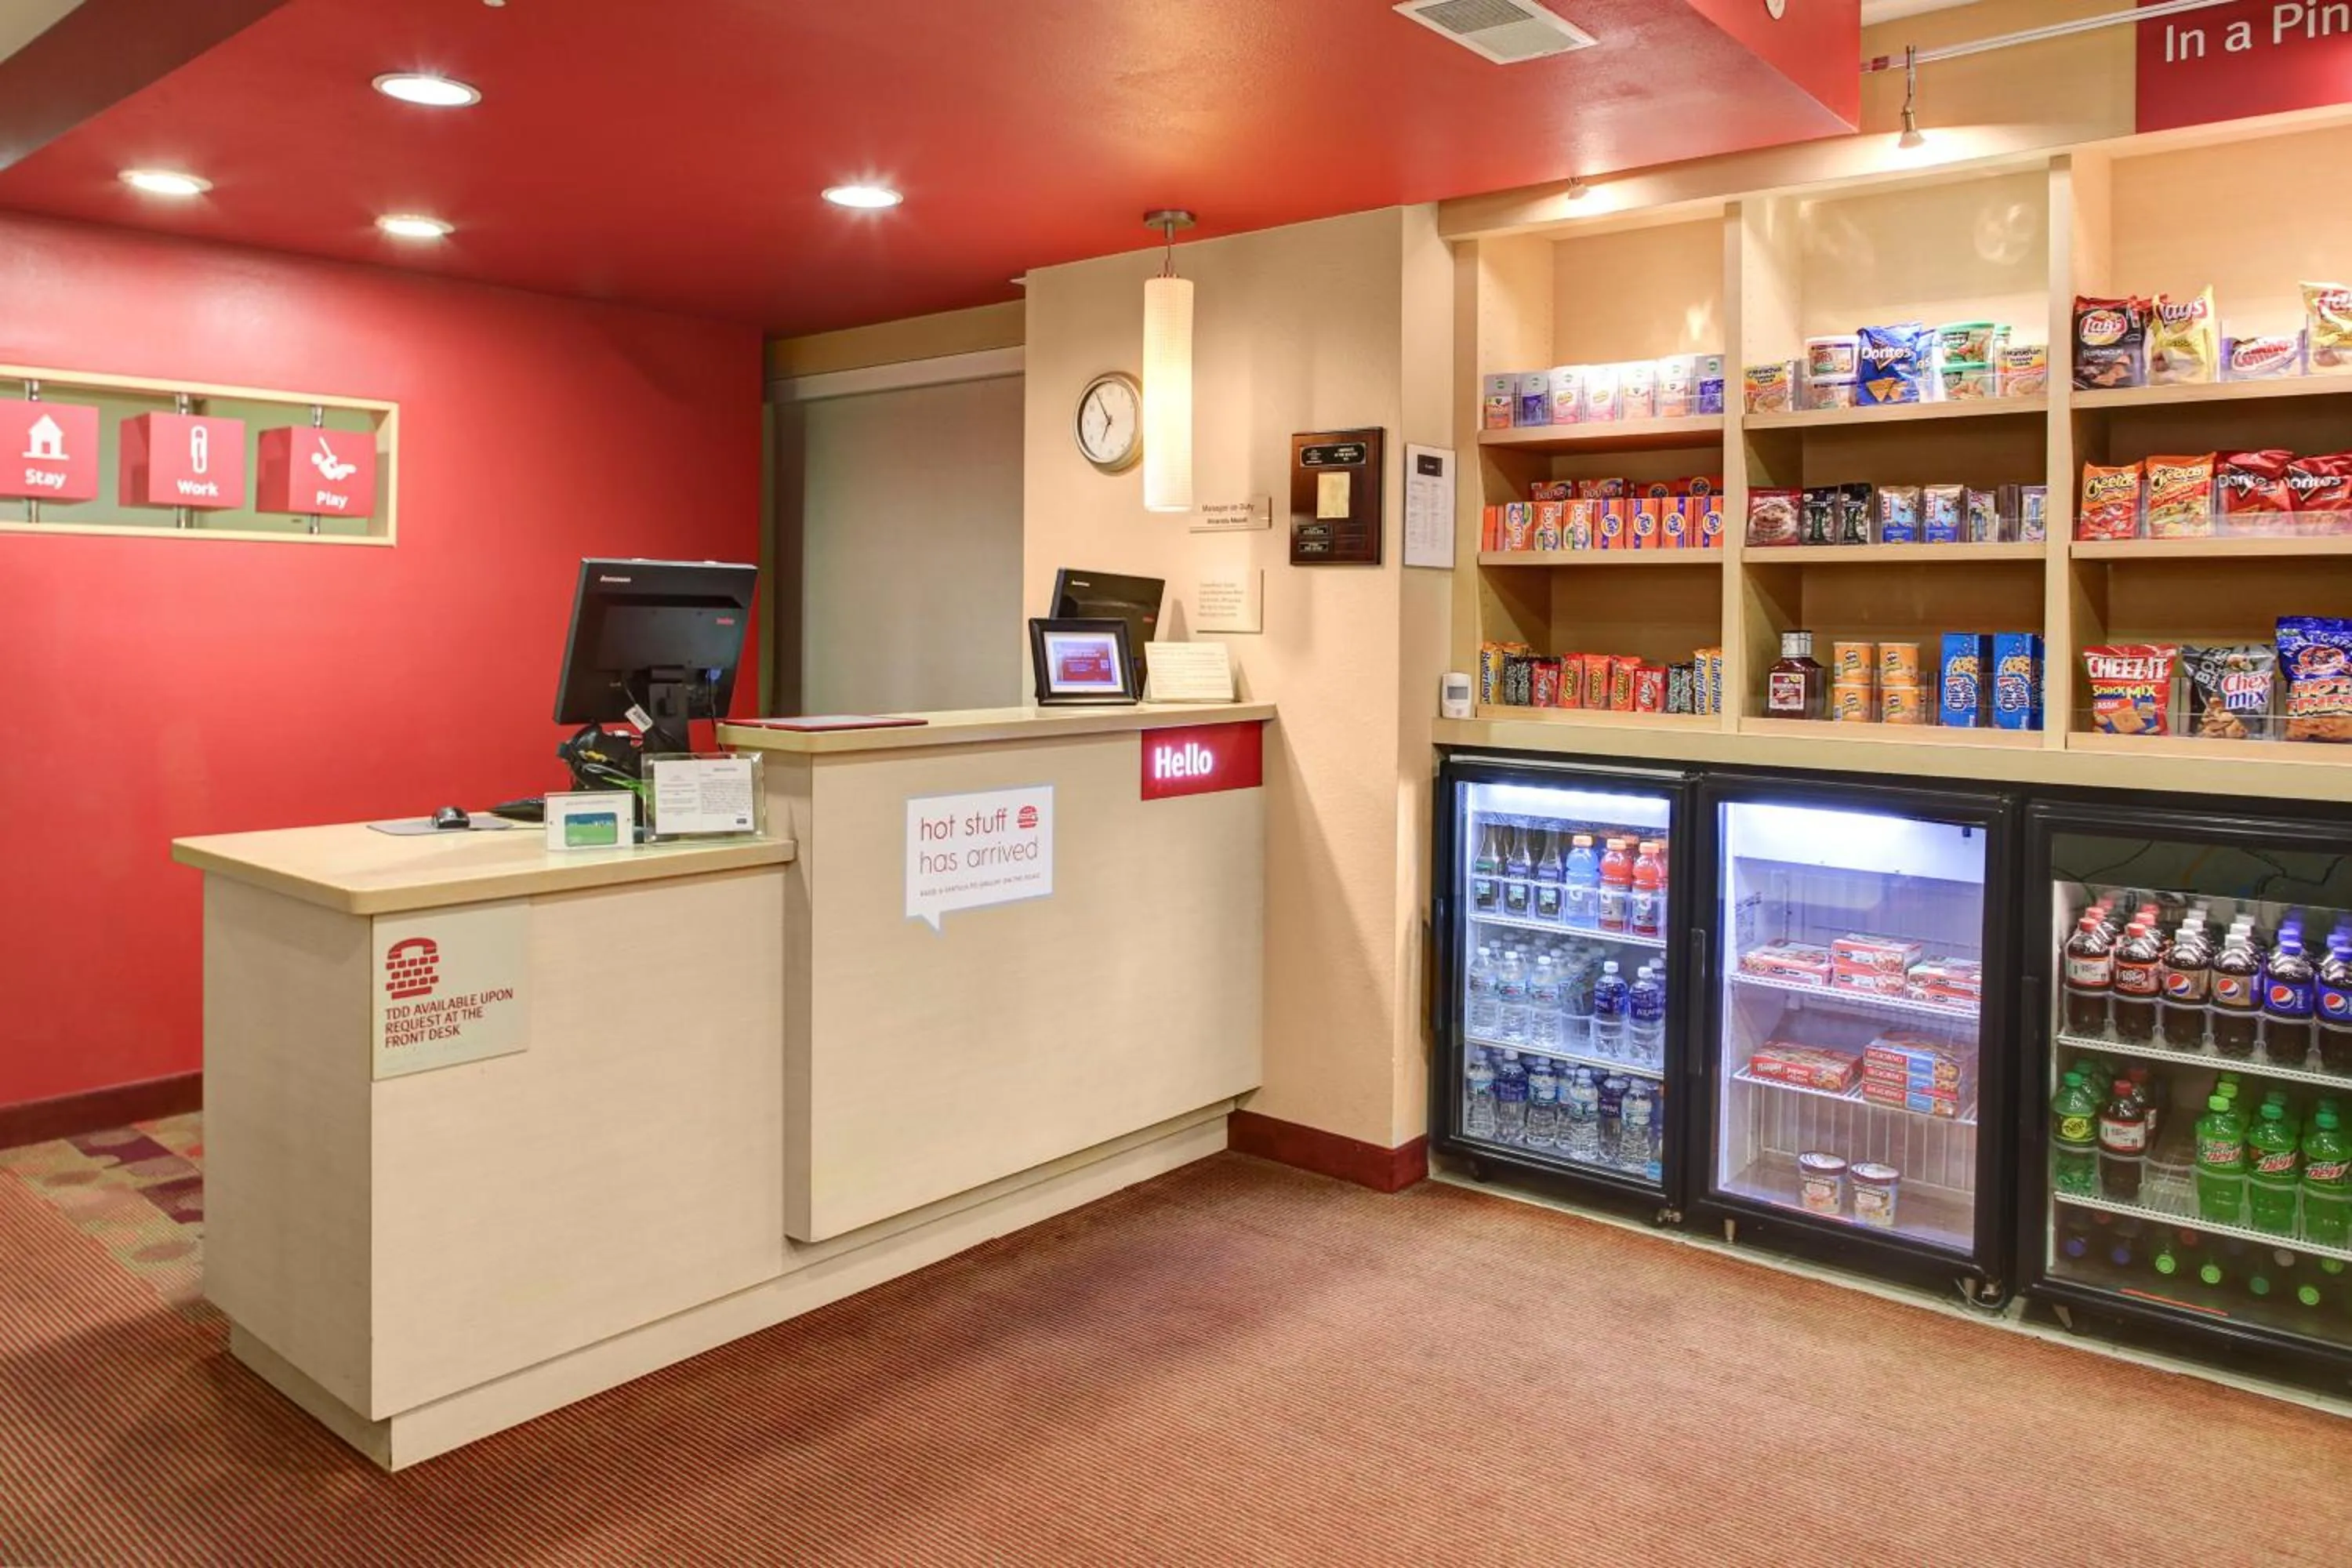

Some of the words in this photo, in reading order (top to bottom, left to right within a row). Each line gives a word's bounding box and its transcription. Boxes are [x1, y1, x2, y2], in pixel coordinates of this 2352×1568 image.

[2165, 24, 2205, 63] In
[2224, 21, 2252, 53] a
[1861, 346, 1912, 360] Doritos
[25, 468, 67, 490] Stay
[177, 479, 219, 497] Work
[316, 491, 349, 510] Play
[2223, 673, 2270, 692] Chex
[1154, 742, 1213, 779] Hello
[920, 815, 956, 841] hot
[965, 808, 1008, 837] stuff
[920, 851, 958, 874] has
[967, 835, 1038, 868] arrived
[386, 1006, 410, 1020] TDD
[413, 993, 477, 1015] AVAILABLE
[480, 988, 514, 1004] UPON
[385, 1014, 441, 1035] REQUEST
[445, 1011, 459, 1023] AT
[462, 1006, 484, 1020] THE
[385, 1030, 425, 1048] FRONT
[429, 1025, 461, 1040] DESK
